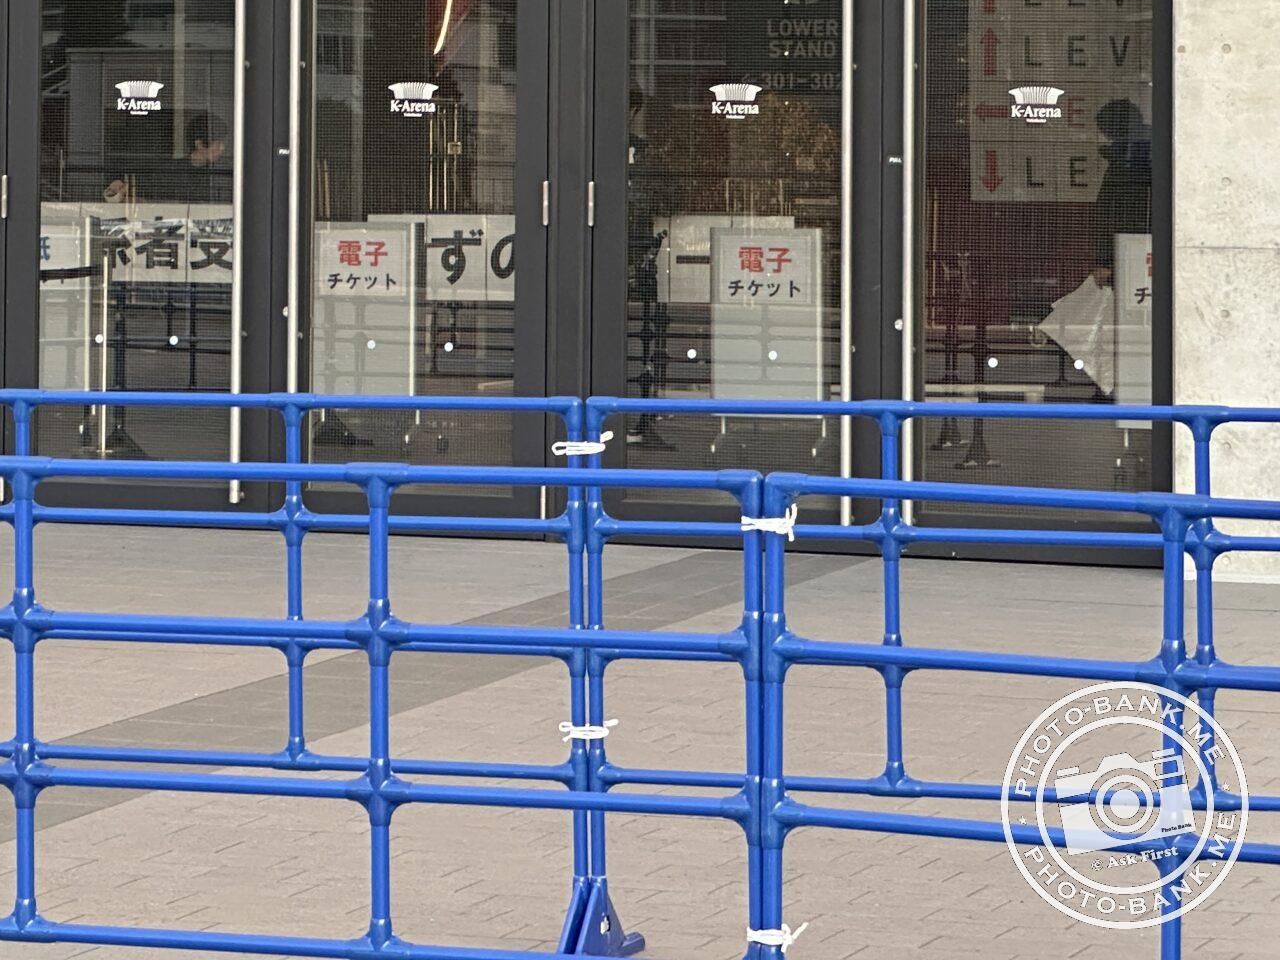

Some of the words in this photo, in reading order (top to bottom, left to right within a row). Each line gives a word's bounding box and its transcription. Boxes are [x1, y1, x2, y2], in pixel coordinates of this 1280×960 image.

[767, 19, 839, 37] LOWER
[769, 40, 836, 58] STAND
[117, 98, 161, 110] K-Arena
[390, 100, 436, 112] K-Arena
[711, 102, 759, 115] K-Arena
[1011, 105, 1062, 118] K-Arena
[338, 240, 389, 268] 電子
[739, 246, 792, 274] 電子
[328, 273, 397, 291] チケット
[728, 279, 801, 298] チケット
